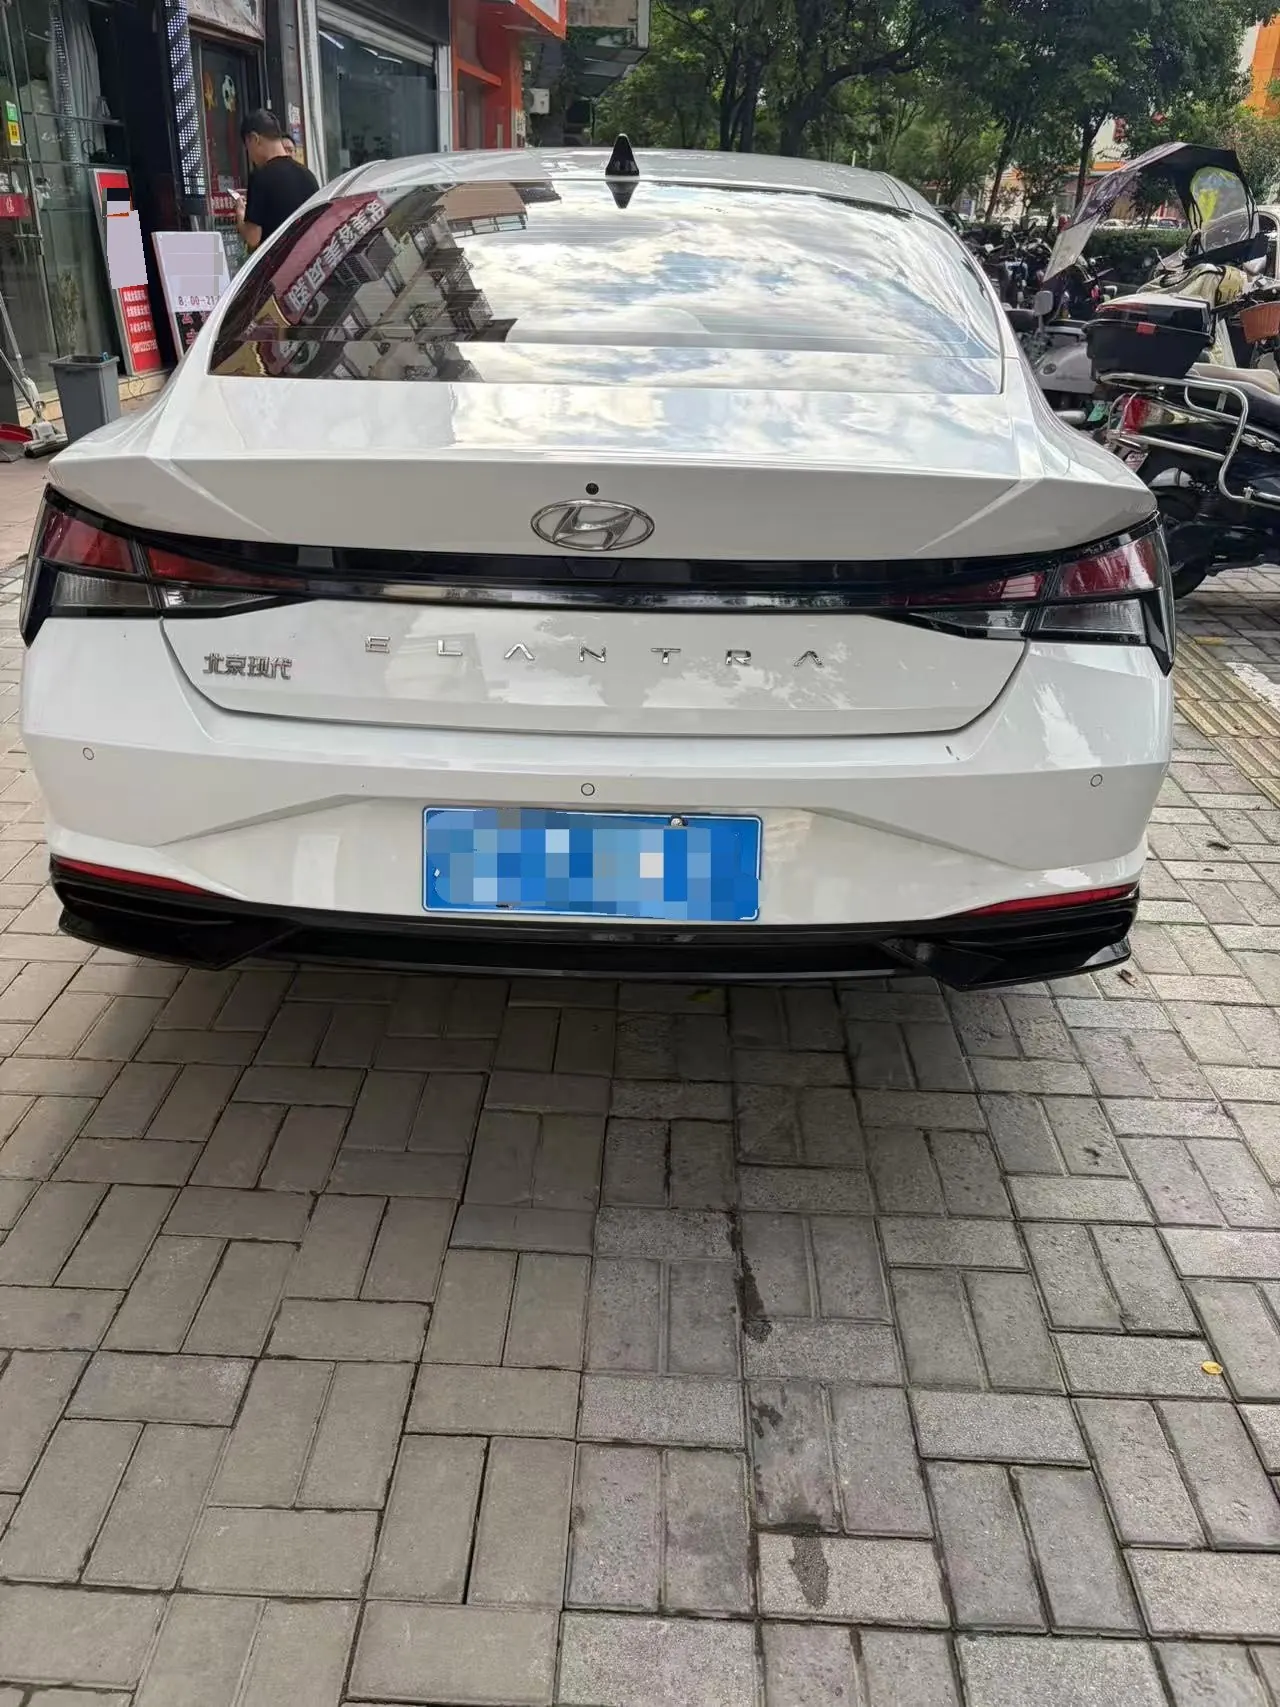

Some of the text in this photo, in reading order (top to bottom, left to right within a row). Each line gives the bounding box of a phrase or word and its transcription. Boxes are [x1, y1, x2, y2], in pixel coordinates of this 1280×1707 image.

[202, 652, 293, 680] 北京现代
[365, 636, 825, 667] ELANTRA
